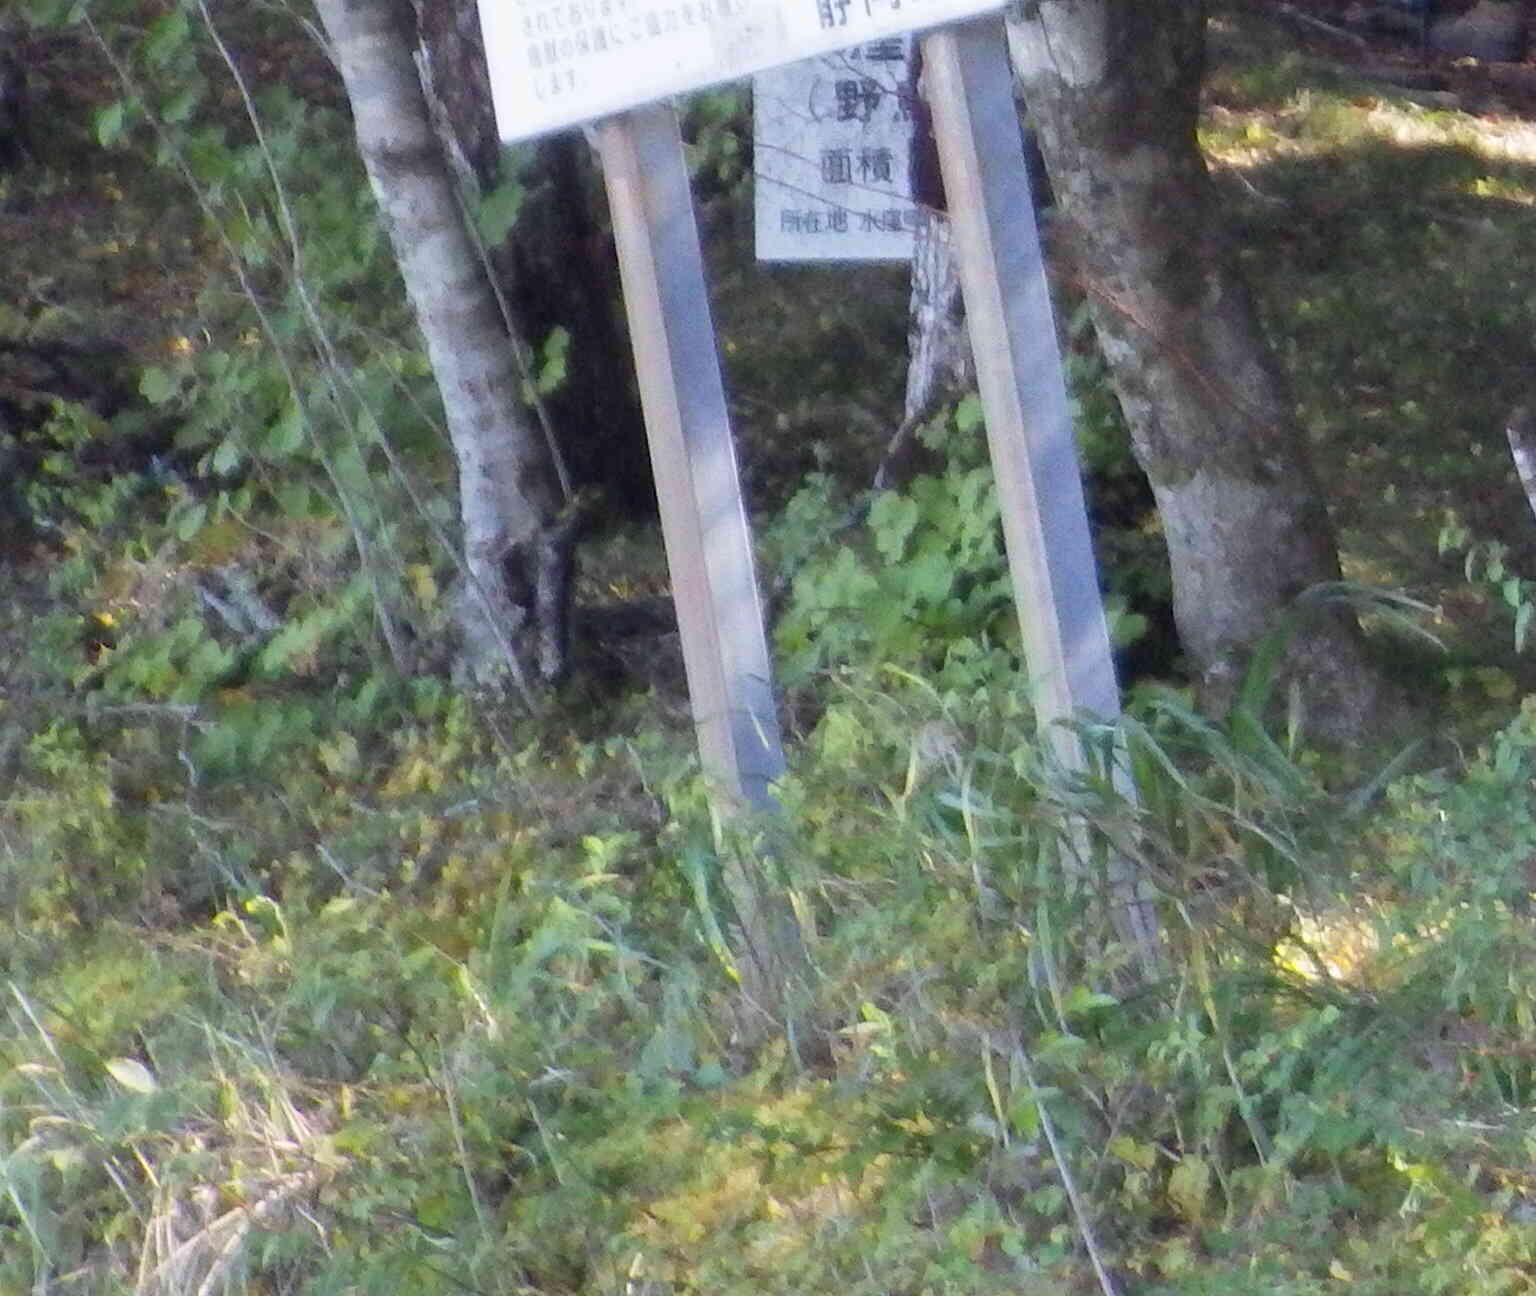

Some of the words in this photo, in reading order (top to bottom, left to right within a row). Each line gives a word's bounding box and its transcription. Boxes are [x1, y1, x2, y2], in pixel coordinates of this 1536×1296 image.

[822, 145, 894, 185] 面積
[779, 208, 850, 235] 所在地
